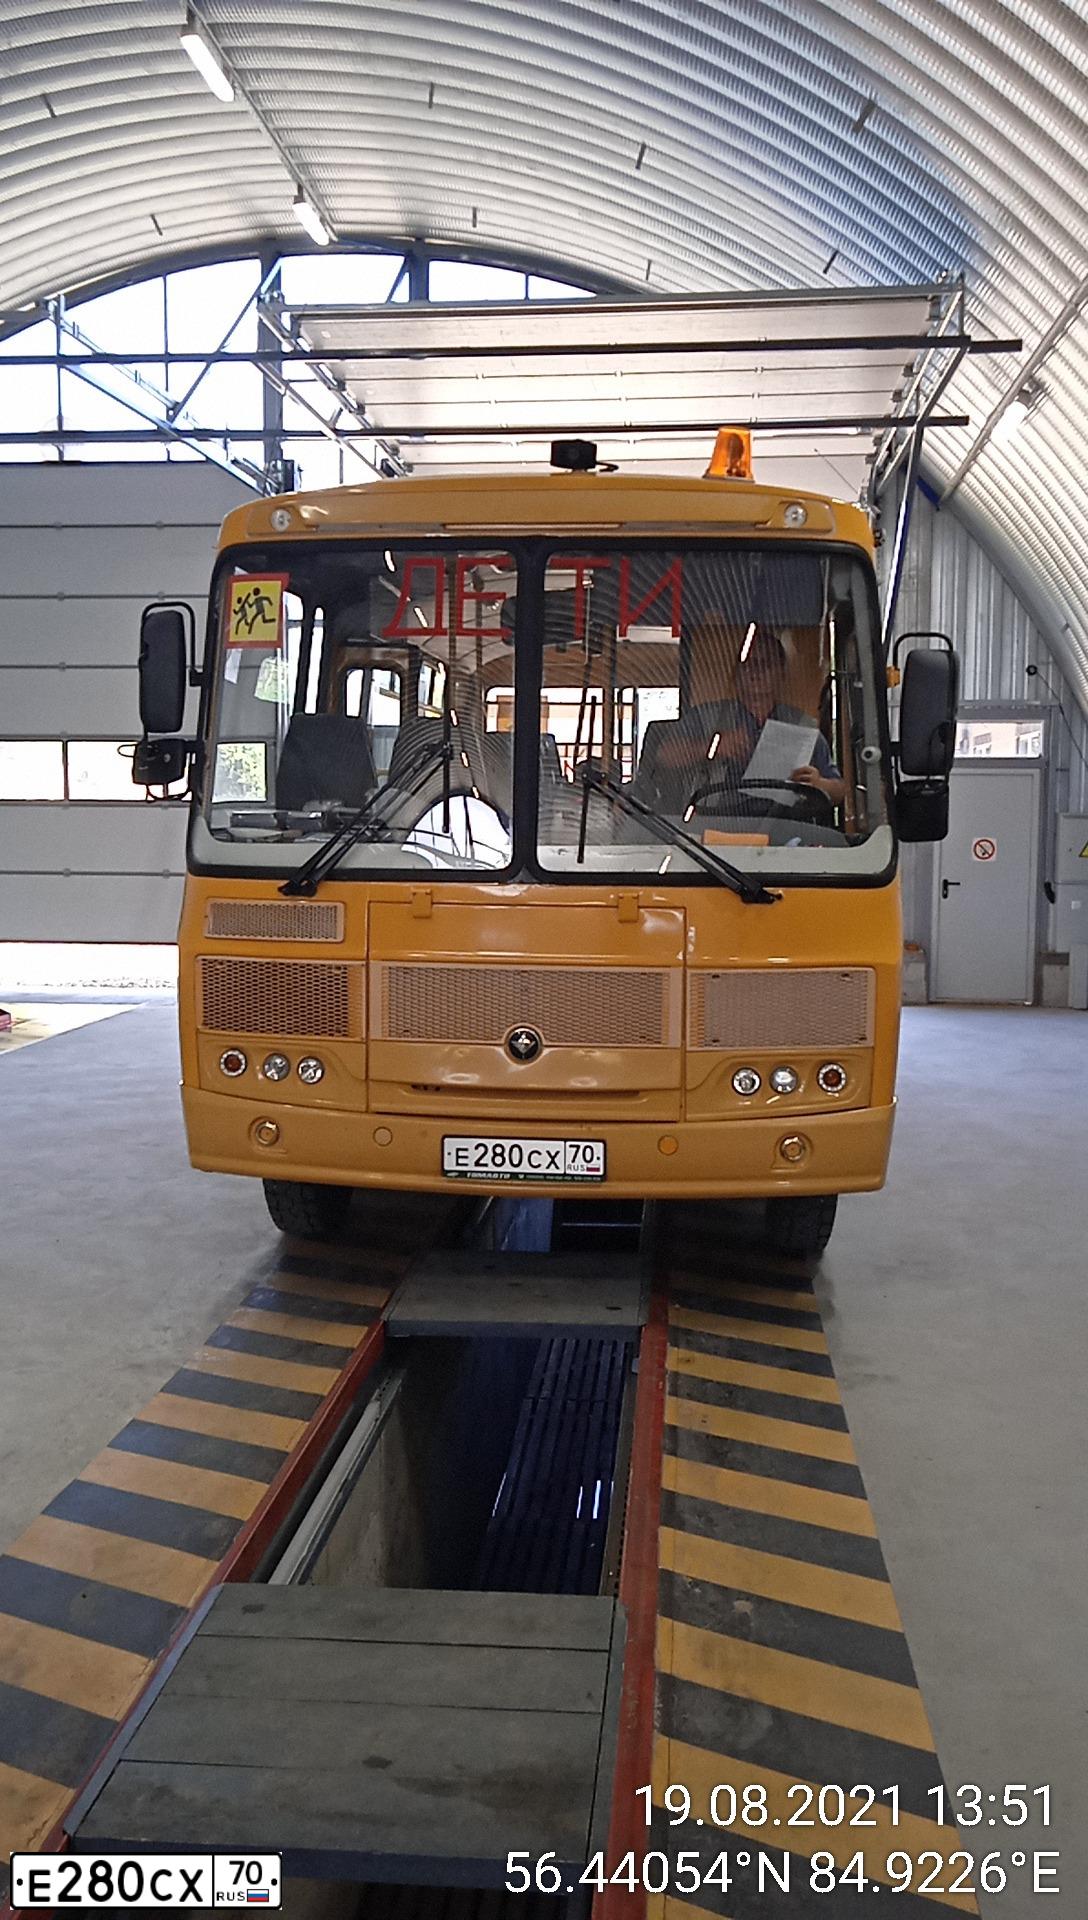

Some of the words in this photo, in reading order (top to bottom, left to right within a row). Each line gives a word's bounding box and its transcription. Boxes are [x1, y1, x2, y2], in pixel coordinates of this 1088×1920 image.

[455, 1143, 560, 1170] Е280СХ
[568, 1144, 595, 1164] 70
[566, 1164, 586, 1172] RUS
